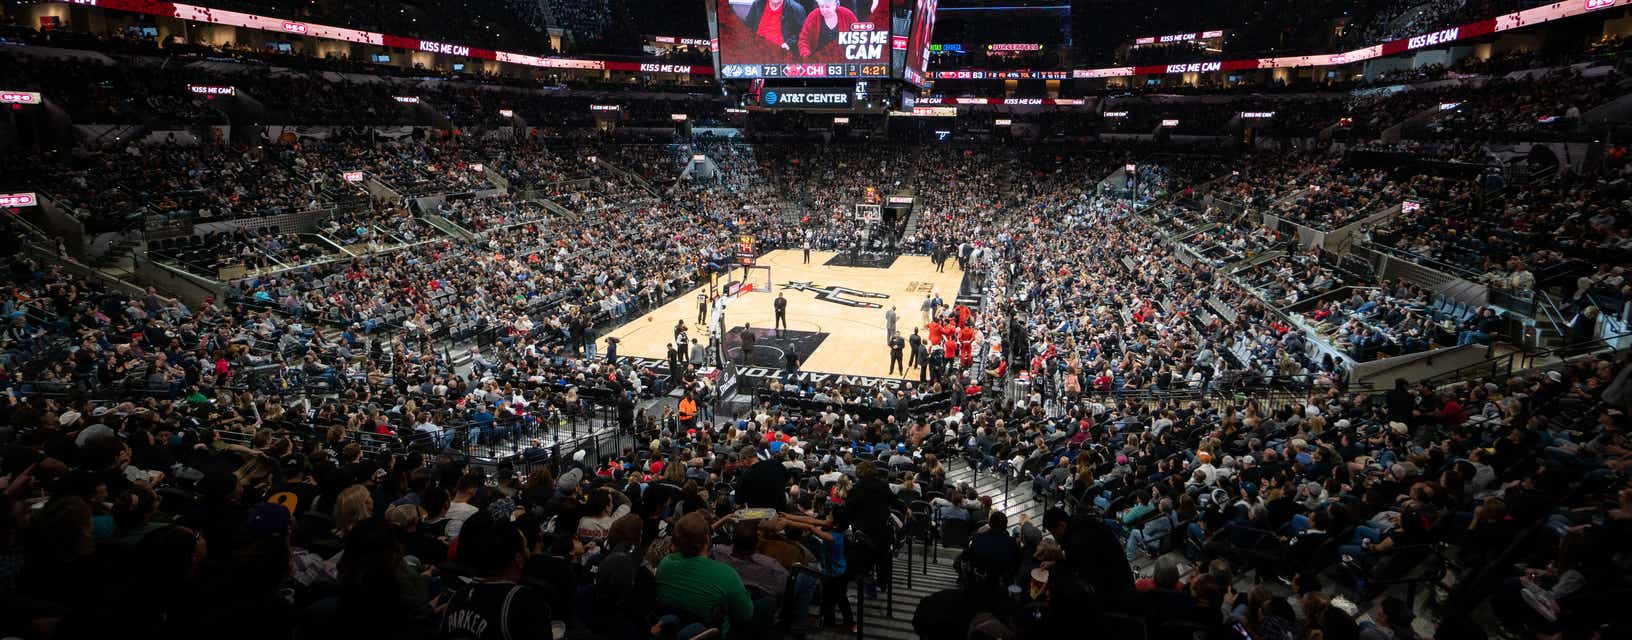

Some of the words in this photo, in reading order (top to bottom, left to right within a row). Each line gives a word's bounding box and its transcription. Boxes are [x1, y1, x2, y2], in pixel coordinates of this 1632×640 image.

[838, 31, 868, 45] KISS
[869, 30, 888, 44] ME
[1408, 36, 1427, 49] KISS
[1427, 34, 1438, 45] ME
[1439, 28, 1458, 43] CAM
[420, 41, 439, 53] KISS
[440, 45, 452, 54] ME
[453, 46, 469, 57] CAM
[845, 45, 882, 60] CAM
[640, 63, 660, 72] KISS
[661, 64, 673, 73] ME
[674, 65, 691, 73] CAM
[743, 66, 758, 76] SA
[764, 66, 777, 76] 72
[806, 66, 824, 76] CHI
[828, 66, 842, 76] 63
[862, 66, 886, 76] 4:21
[1166, 63, 1186, 73] KISS
[1187, 63, 1200, 72] ME
[1201, 61, 1221, 72] CAM
[958, 71, 971, 79] CHI
[191, 86, 207, 94] KISS
[218, 87, 231, 95] CAM
[779, 93, 806, 103] AT&T
[806, 93, 848, 103] CENTER
